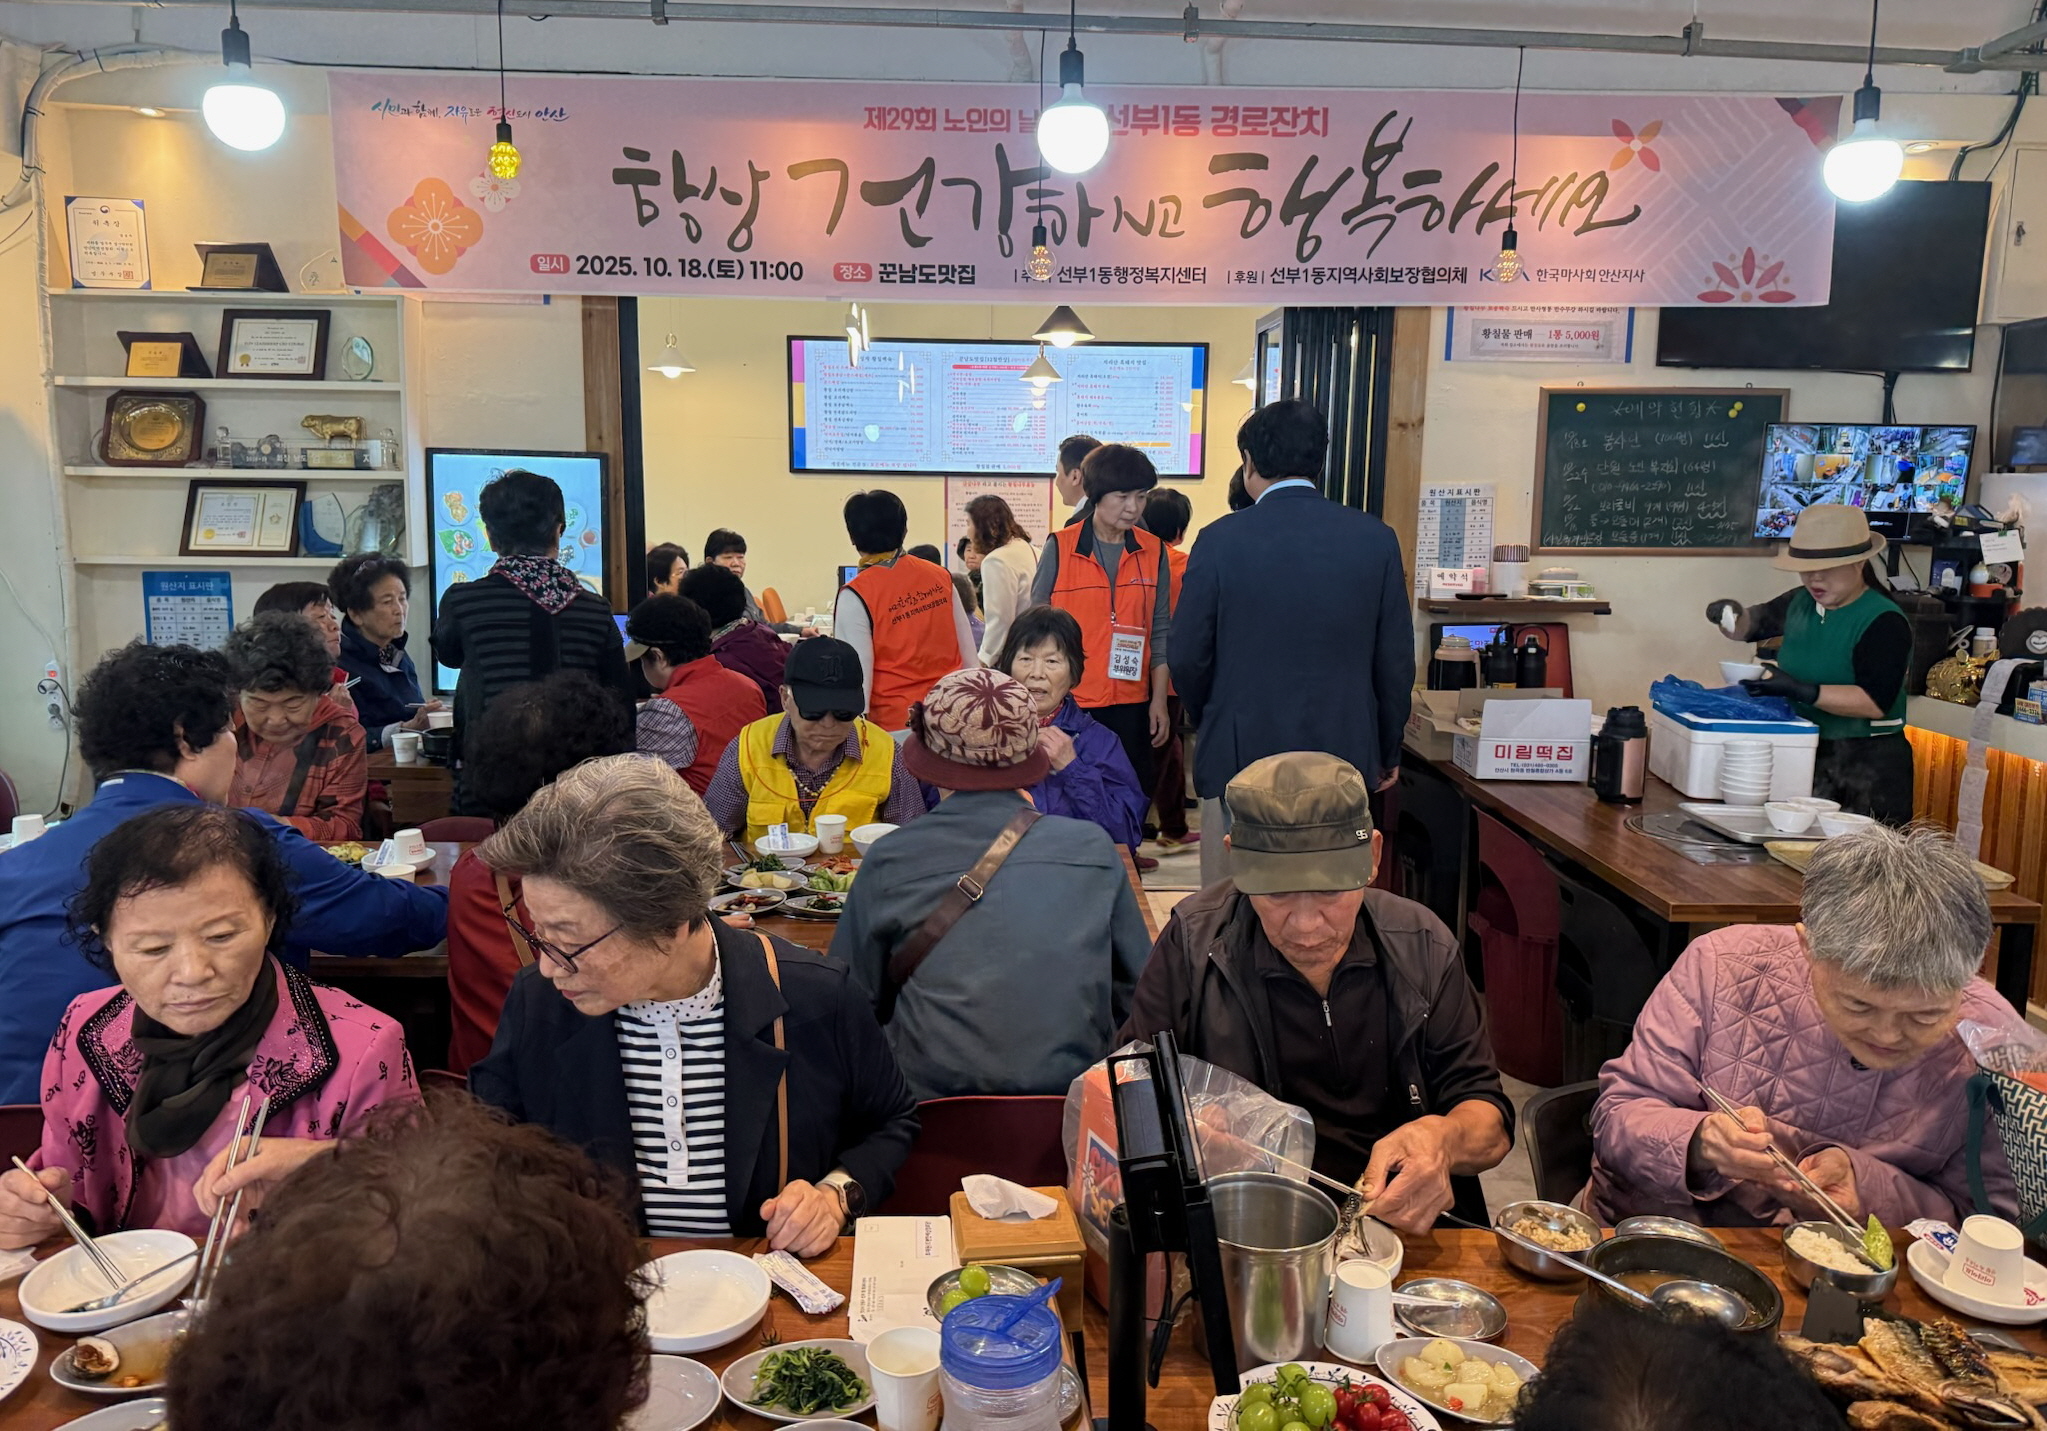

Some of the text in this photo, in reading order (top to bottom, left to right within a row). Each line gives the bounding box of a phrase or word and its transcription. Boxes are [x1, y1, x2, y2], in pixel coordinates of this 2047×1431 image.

[534, 107, 570, 122] 안산
[863, 105, 937, 132] 제29회
[942, 107, 1011, 133] 노인의
[1210, 105, 1329, 138] 경로잔치
[612, 146, 770, 252] 항상
[1202, 110, 1642, 263] 행복하세요
[536, 255, 564, 272] 일시
[575, 255, 638, 276] 2025.
[643, 257, 672, 277] 10.
[678, 258, 744, 281] 18.(토)
[749, 260, 804, 282] 11:00
[839, 264, 867, 281] 장소
[878, 263, 976, 286] 꾼남도맛집
[1057, 265, 1207, 285] 선부1동행정복지센터
[1233, 269, 1258, 284] 후원
[1270, 266, 1467, 285] 선부1동지역사회보장협의체
[1536, 268, 1596, 283] 한국마사회
[1598, 268, 1646, 283] 안산지사
[1481, 328, 1511, 340] 황칠물
[1513, 328, 1533, 340] 판매
[1565, 330, 1600, 341] 5,000원
[1429, 488, 1481, 497] 원산지표시판
[160, 581, 214, 591] 원산지 표시판
[1114, 653, 1139, 665] 김성숙
[1113, 664, 1138, 677] 부위원장
[1495, 744, 1573, 761] 미림떡집
